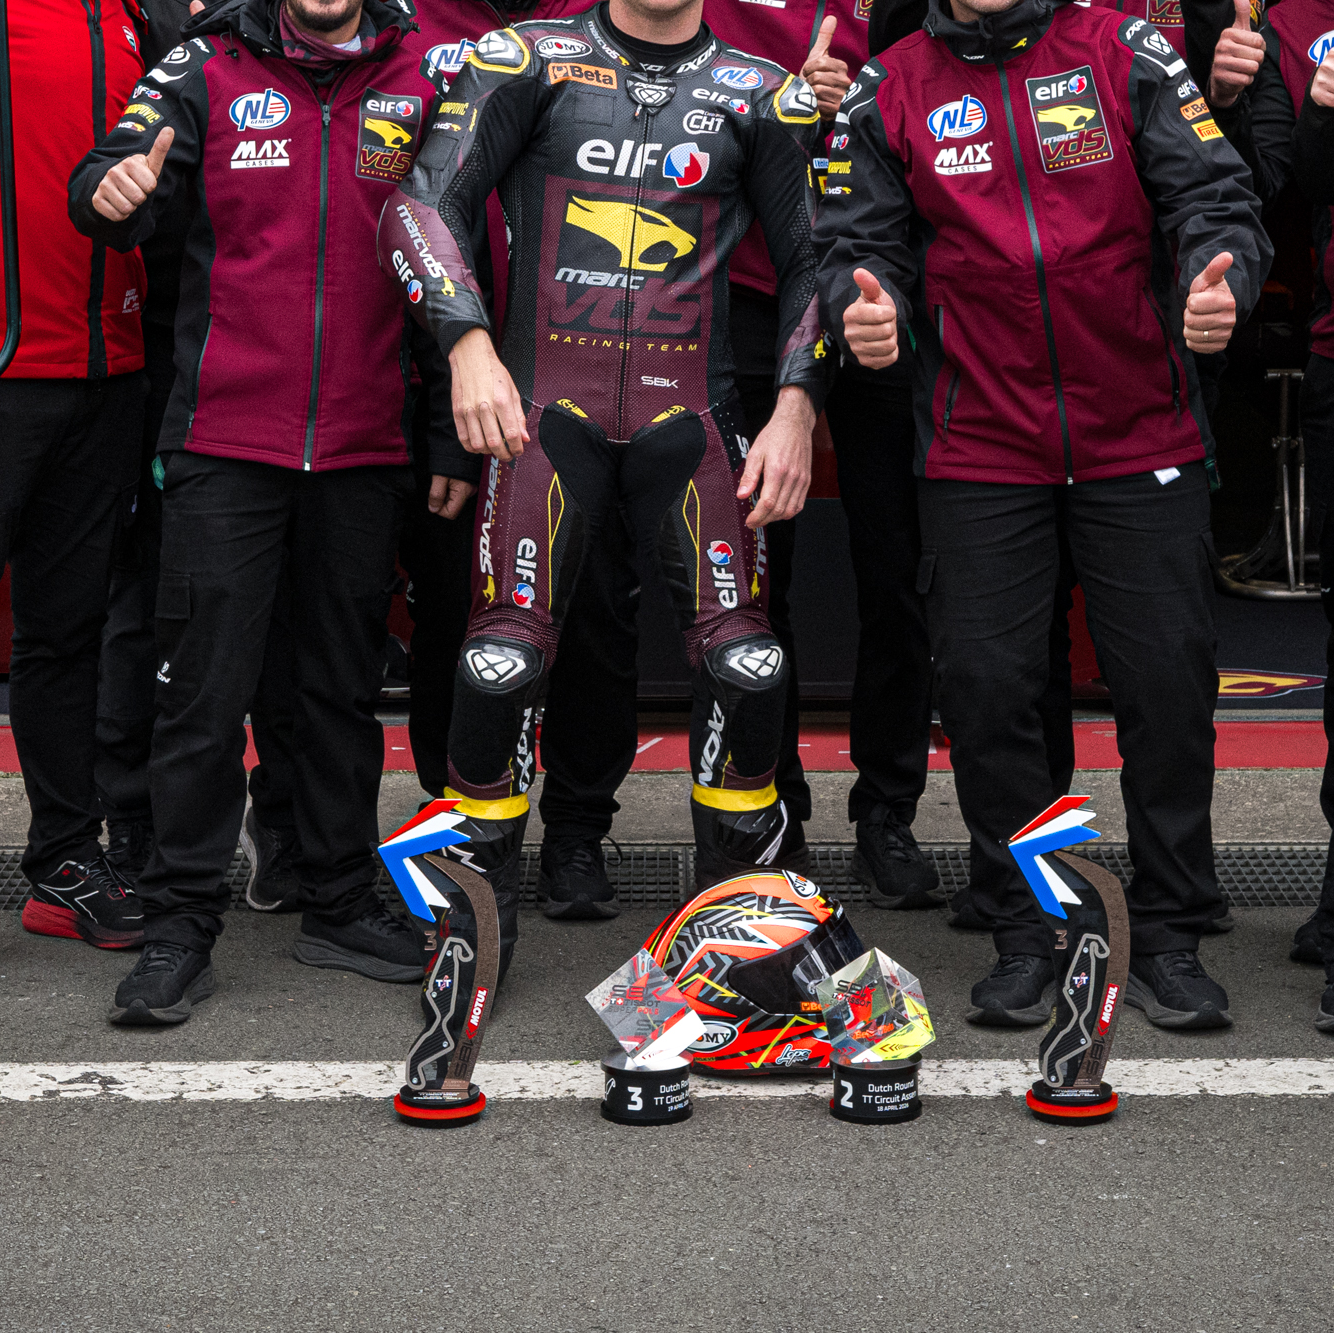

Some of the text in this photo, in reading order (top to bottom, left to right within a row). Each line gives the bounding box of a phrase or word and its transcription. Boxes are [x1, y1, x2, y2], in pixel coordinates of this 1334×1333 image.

[676, 39, 717, 74] IXON
[569, 66, 615, 86] Beta
[692, 88, 731, 104] elf
[1034, 80, 1067, 101] elf
[366, 99, 396, 113] elf
[1193, 102, 1208, 115] Be
[1042, 131, 1079, 145] marc
[231, 139, 289, 160] MAX
[576, 138, 662, 178] elf
[934, 142, 992, 166] MAX
[947, 165, 978, 175] CASES
[1048, 152, 1109, 169] RACING TEAM
[360, 168, 388, 178] RACING
[396, 203, 449, 279] marcvds
[392, 249, 415, 283] elf
[555, 267, 644, 290] marc
[549, 333, 698, 352] RACING TEAM
[641, 375, 679, 389] SBK
[515, 537, 538, 584] elf
[712, 566, 738, 610] elf
[423, 930, 438, 952] 3
[1054, 929, 1069, 950] 3
[469, 989, 487, 1027] MOTUL
[1101, 986, 1118, 1024] MOTUL
[696, 1032, 730, 1044] OMY
[659, 1082, 681, 1094] Dutch
[840, 1079, 854, 1109] 2
[868, 1079, 915, 1093] Dutch Round
[627, 1086, 644, 1112] 3
[653, 1096, 665, 1106] TT
[666, 1092, 685, 1105] Circuit
[862, 1094, 873, 1104] TT
[874, 1092, 900, 1104] Circuit
[883, 1104, 898, 1112] APRIL
